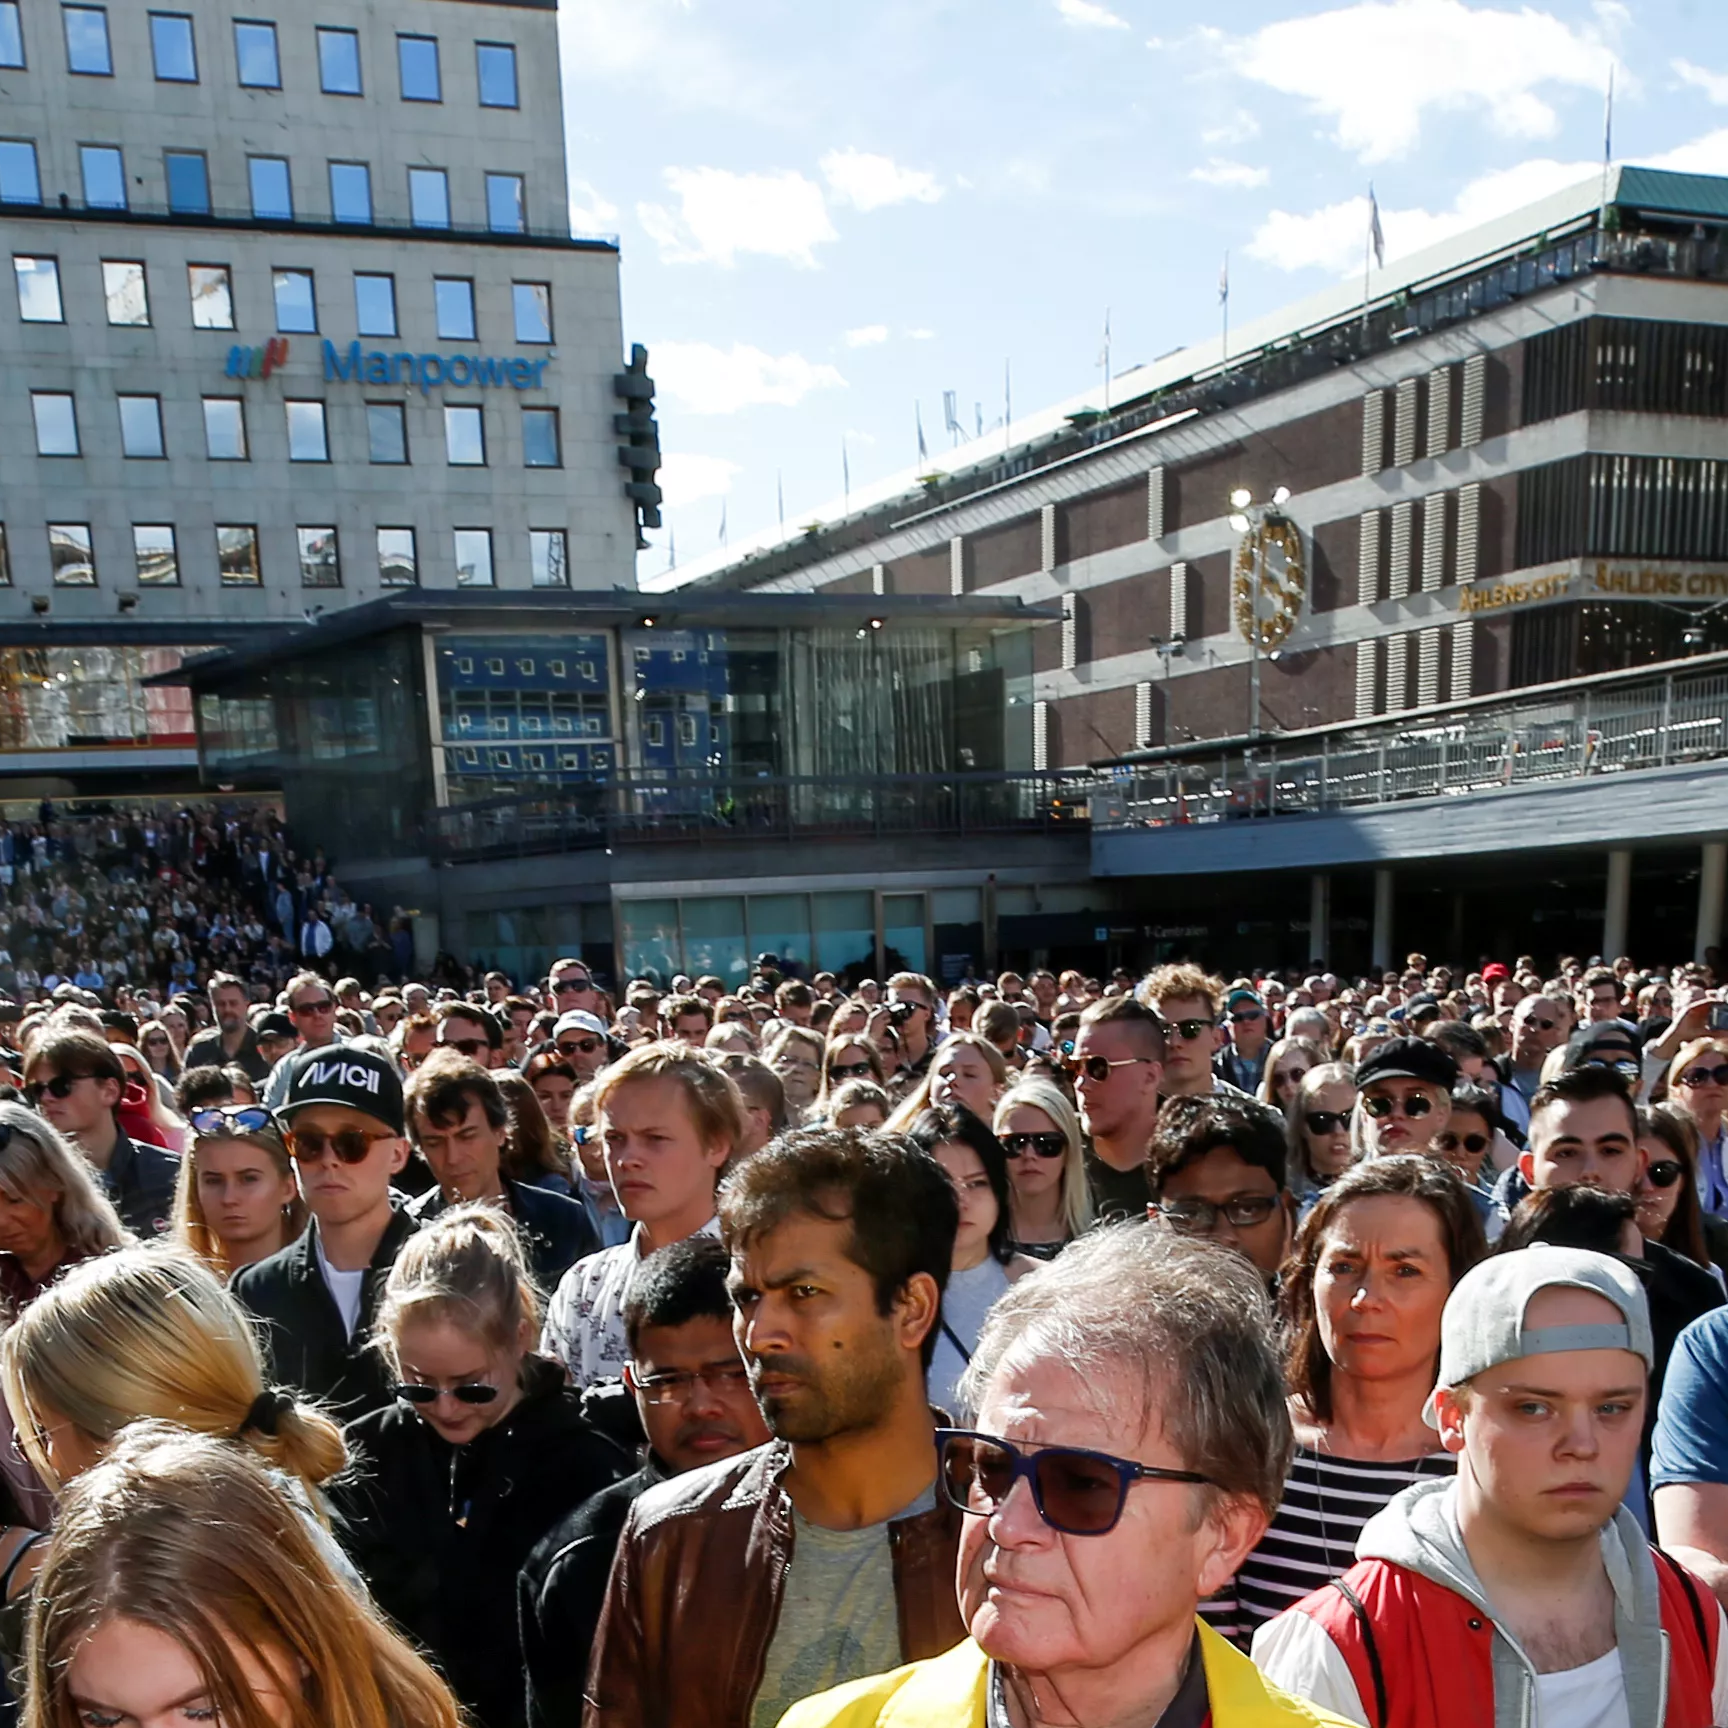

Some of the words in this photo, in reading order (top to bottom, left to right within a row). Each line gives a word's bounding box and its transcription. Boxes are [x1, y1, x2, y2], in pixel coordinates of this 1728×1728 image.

[323, 339, 547, 393] Manpower
[1531, 572, 1570, 600] CITY
[1595, 561, 1683, 595] ÅHLÉNS
[297, 1061, 381, 1095] AVICII
